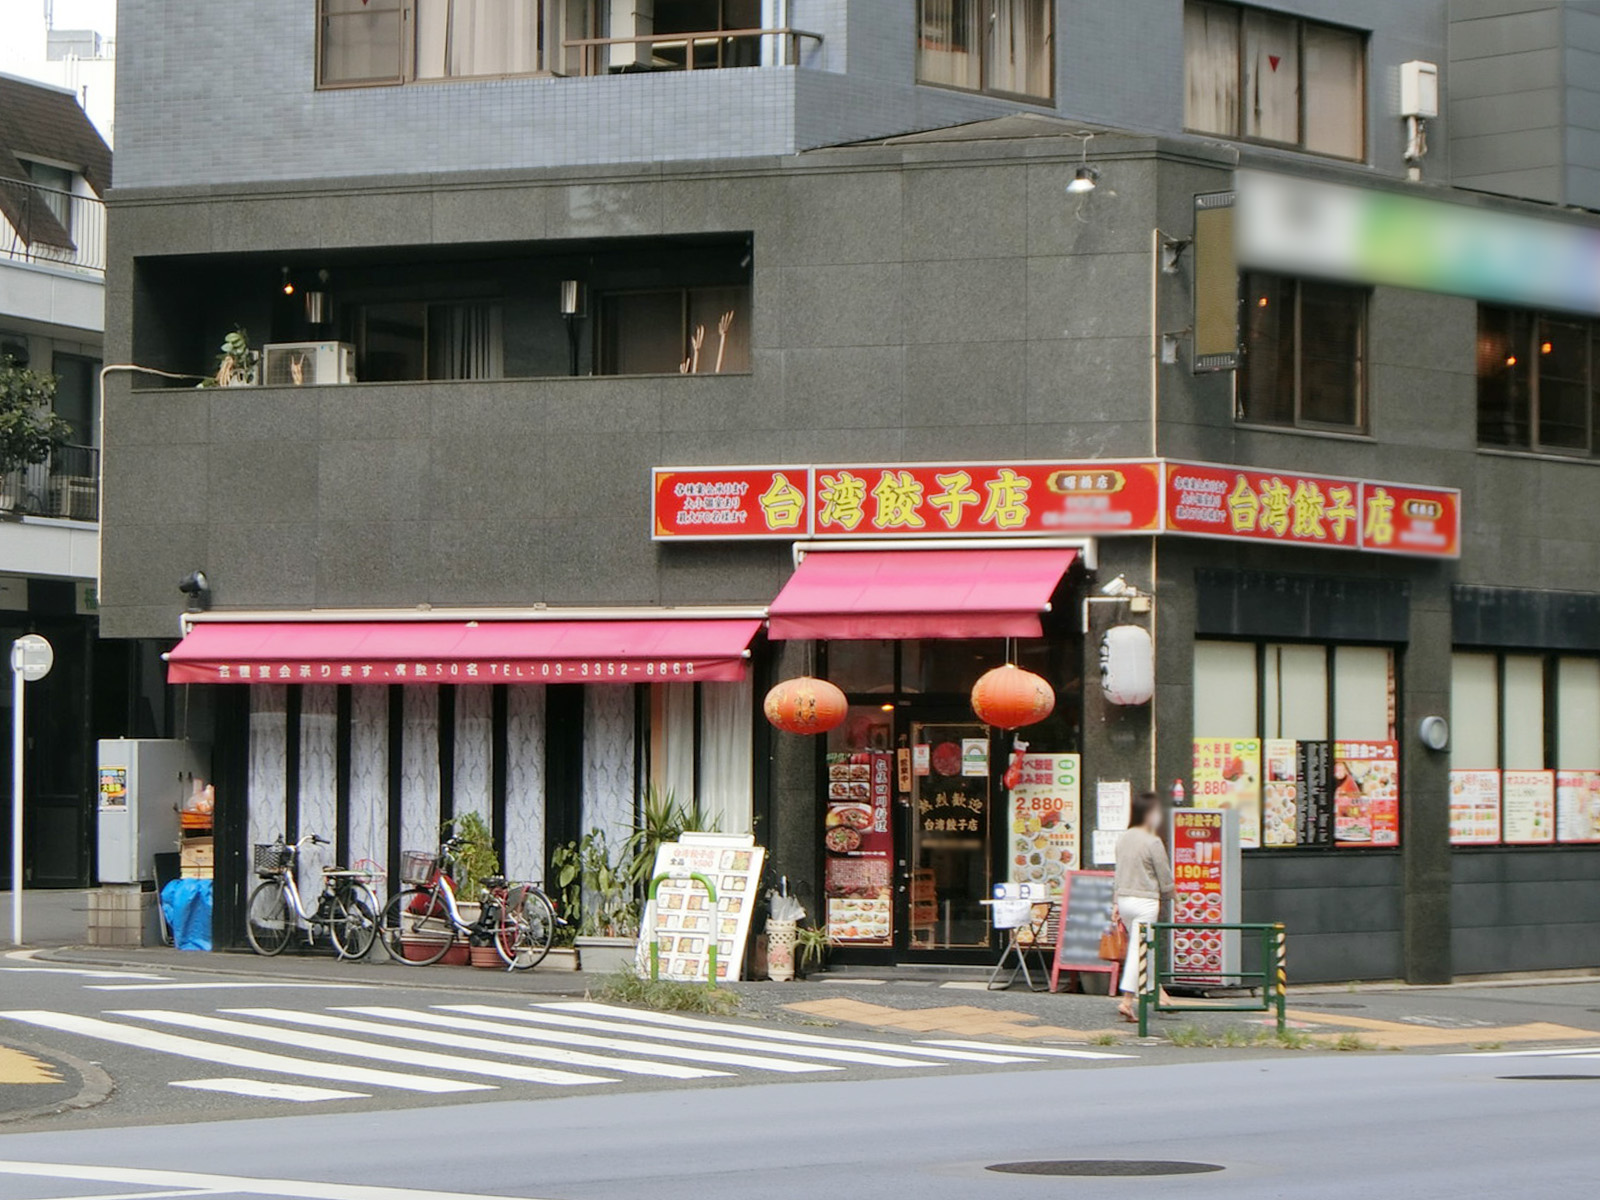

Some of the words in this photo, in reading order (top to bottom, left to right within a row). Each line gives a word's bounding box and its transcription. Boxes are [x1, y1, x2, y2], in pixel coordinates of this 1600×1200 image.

[759, 469, 1032, 530] 台湾餃子店
[1227, 474, 1395, 545] 台湾餃子店
